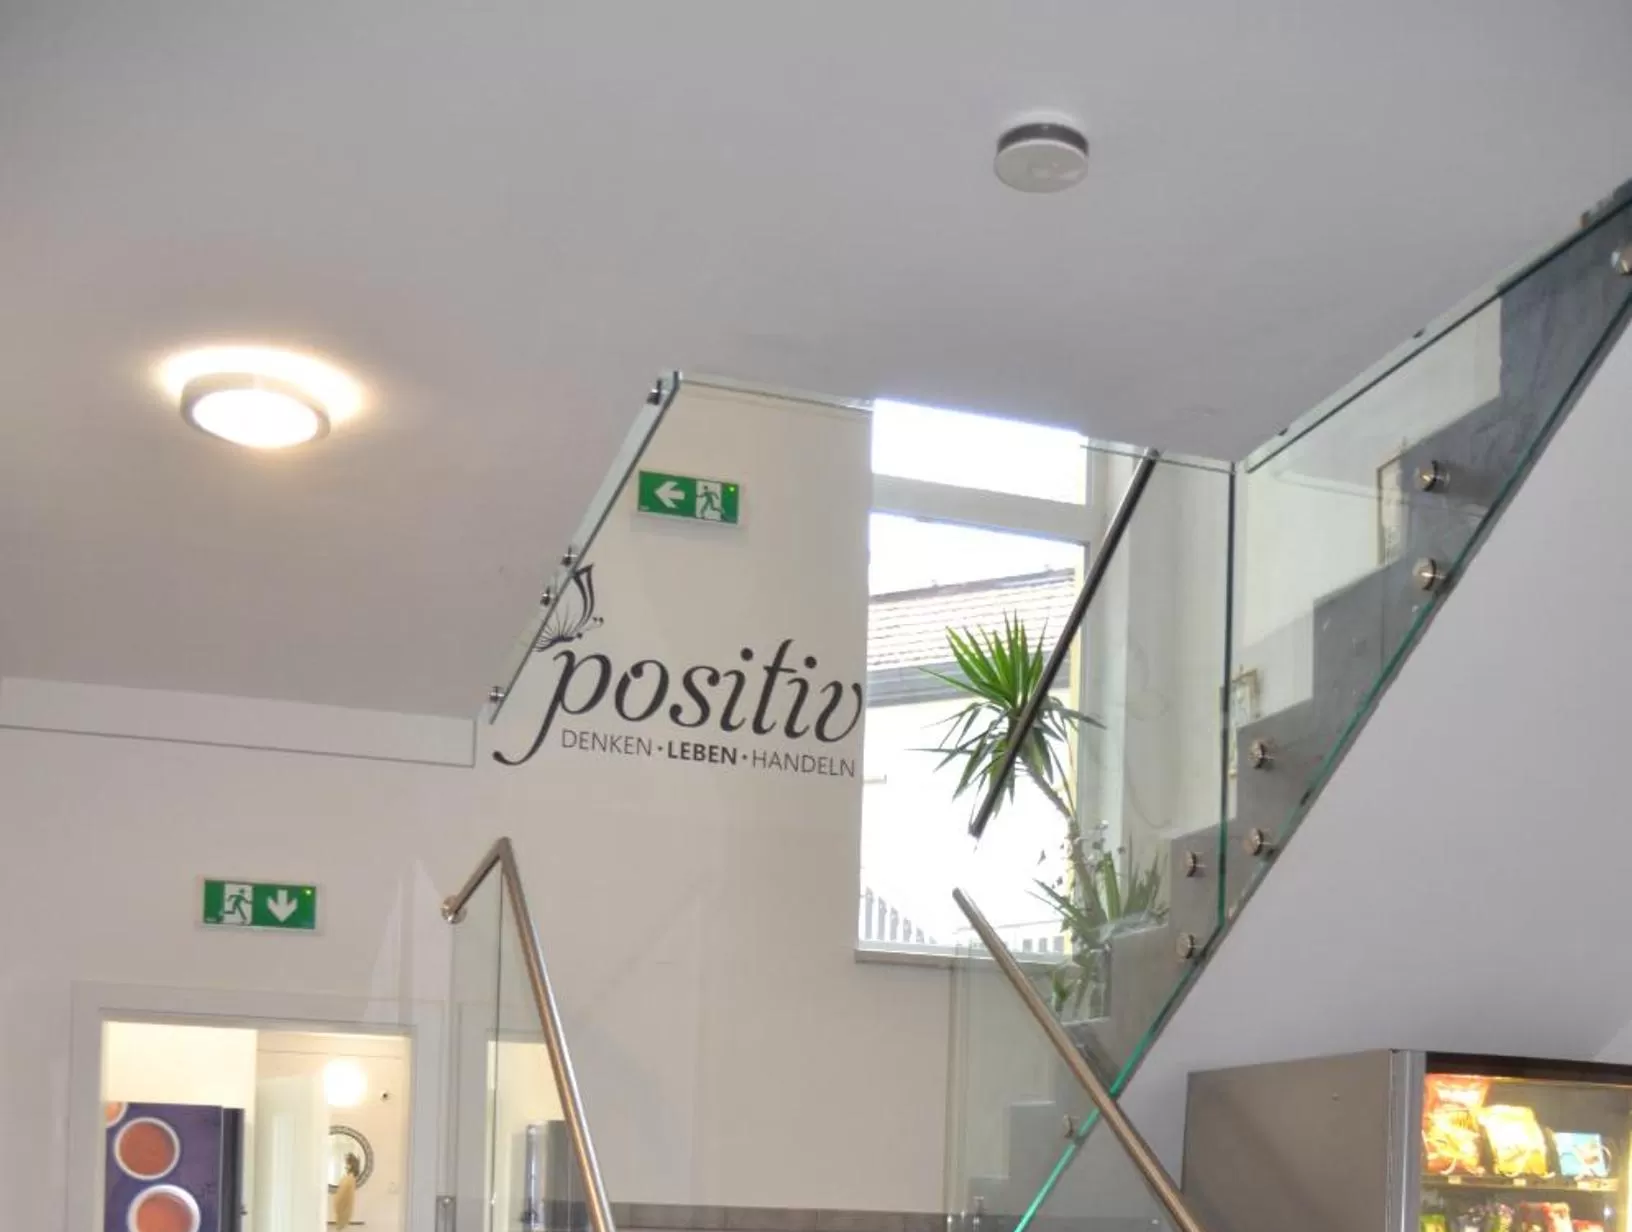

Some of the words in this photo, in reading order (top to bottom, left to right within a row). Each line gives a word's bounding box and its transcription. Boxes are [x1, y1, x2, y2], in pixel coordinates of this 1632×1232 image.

[492, 639, 863, 766] positiv
[561, 729, 653, 756] DENKEN
[667, 741, 737, 765] LEBEN
[752, 749, 855, 777] HANDELN
